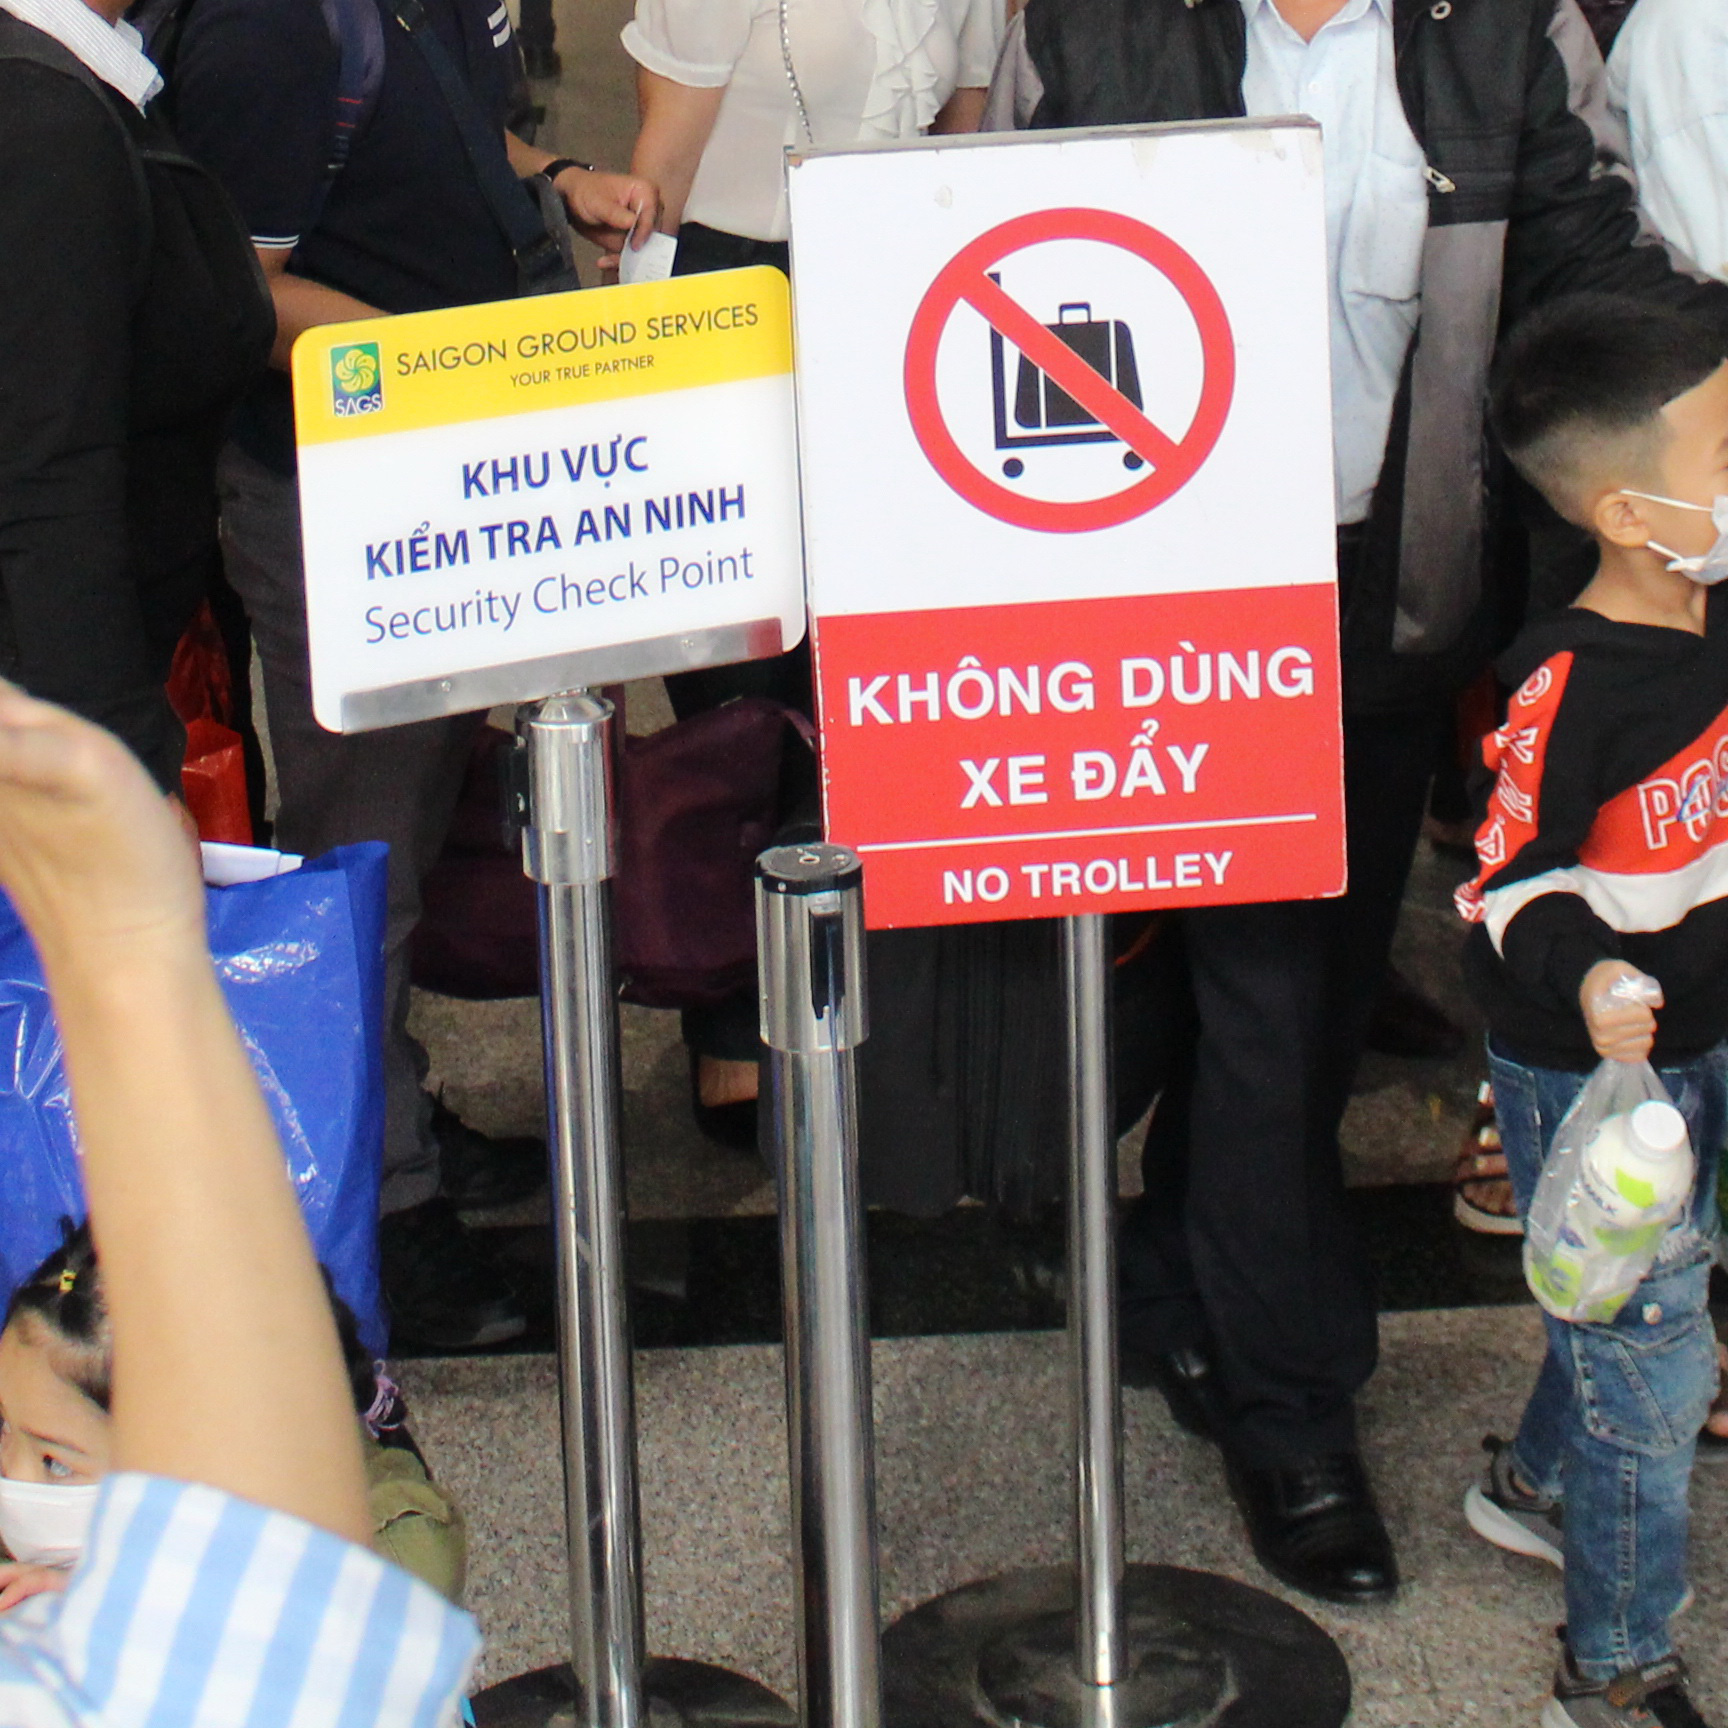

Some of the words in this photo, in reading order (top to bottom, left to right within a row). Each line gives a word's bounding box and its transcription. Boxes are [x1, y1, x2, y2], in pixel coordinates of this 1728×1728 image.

[396, 339, 508, 377] SAIGON
[517, 320, 637, 360] GROUND
[647, 303, 759, 341] SERVICES
[511, 369, 551, 389] YOUR
[556, 362, 591, 382] TRUE
[595, 354, 655, 377] PARTNER
[334, 393, 383, 418] SAGS
[461, 450, 551, 500] KHU
[561, 433, 649, 488] VỰC
[365, 521, 471, 581] KIỂM
[480, 516, 562, 562] TRA
[574, 503, 632, 547] AN
[644, 484, 747, 536] NINH
[365, 589, 522, 644] Security
[532, 563, 649, 615] Check
[660, 546, 755, 594] Point
[847, 655, 1096, 727] KHÔNG
[1121, 640, 1315, 706] DÙNG
[960, 755, 1047, 809] XE
[1071, 720, 1210, 802] ĐẨY
[943, 869, 1009, 905] NO
[1021, 851, 1234, 900] TROLLEY
